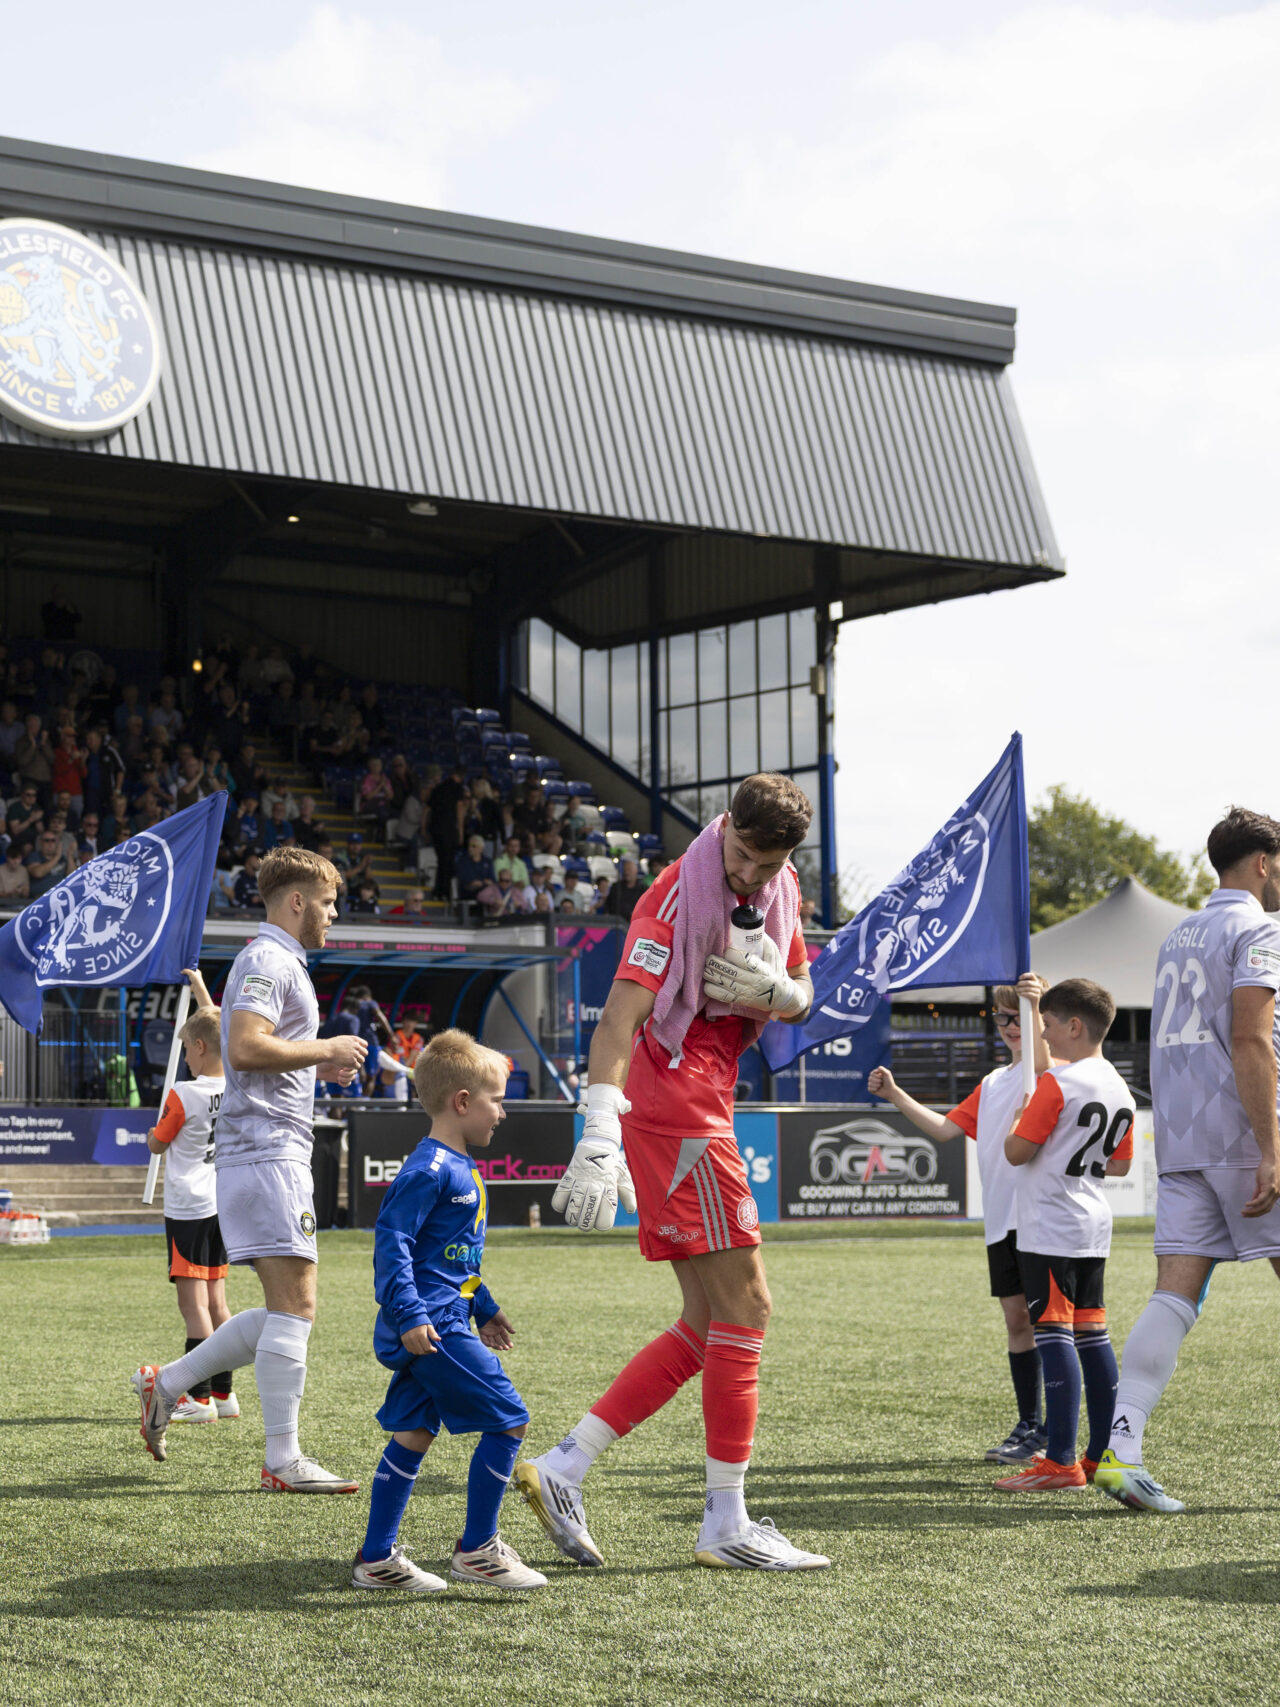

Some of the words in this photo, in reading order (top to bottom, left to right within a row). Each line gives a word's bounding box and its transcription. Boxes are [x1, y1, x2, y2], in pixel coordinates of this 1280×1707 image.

[110, 288, 138, 321] FC
[94, 376, 136, 412] 1874
[708, 958, 738, 978] precision
[1156, 958, 1216, 1048] 22
[0, 1117, 10, 1127] to
[10, 1116, 28, 1129] Tap
[38, 1118, 64, 1130] every
[5, 1144, 23, 1155] and
[1065, 1101, 1133, 1179] 29
[363, 1154, 569, 1182] baack.com
[840, 1145, 908, 1183] GAS
[799, 1185, 863, 1200] GOODWINS
[865, 1185, 898, 1199] AUTO
[898, 1184, 950, 1199] SALVAGE
[582, 1195, 598, 1228] precision
[788, 1203, 806, 1215] WE
[808, 1203, 828, 1215] BUY
[828, 1202, 850, 1215] ANY
[851, 1202, 873, 1215] CAR
[874, 1202, 885, 1214] IN
[885, 1202, 906, 1214] ANY
[907, 1201, 959, 1214] CONDITION
[671, 1231, 700, 1244] GROUP
[443, 1243, 484, 1264] CONC
